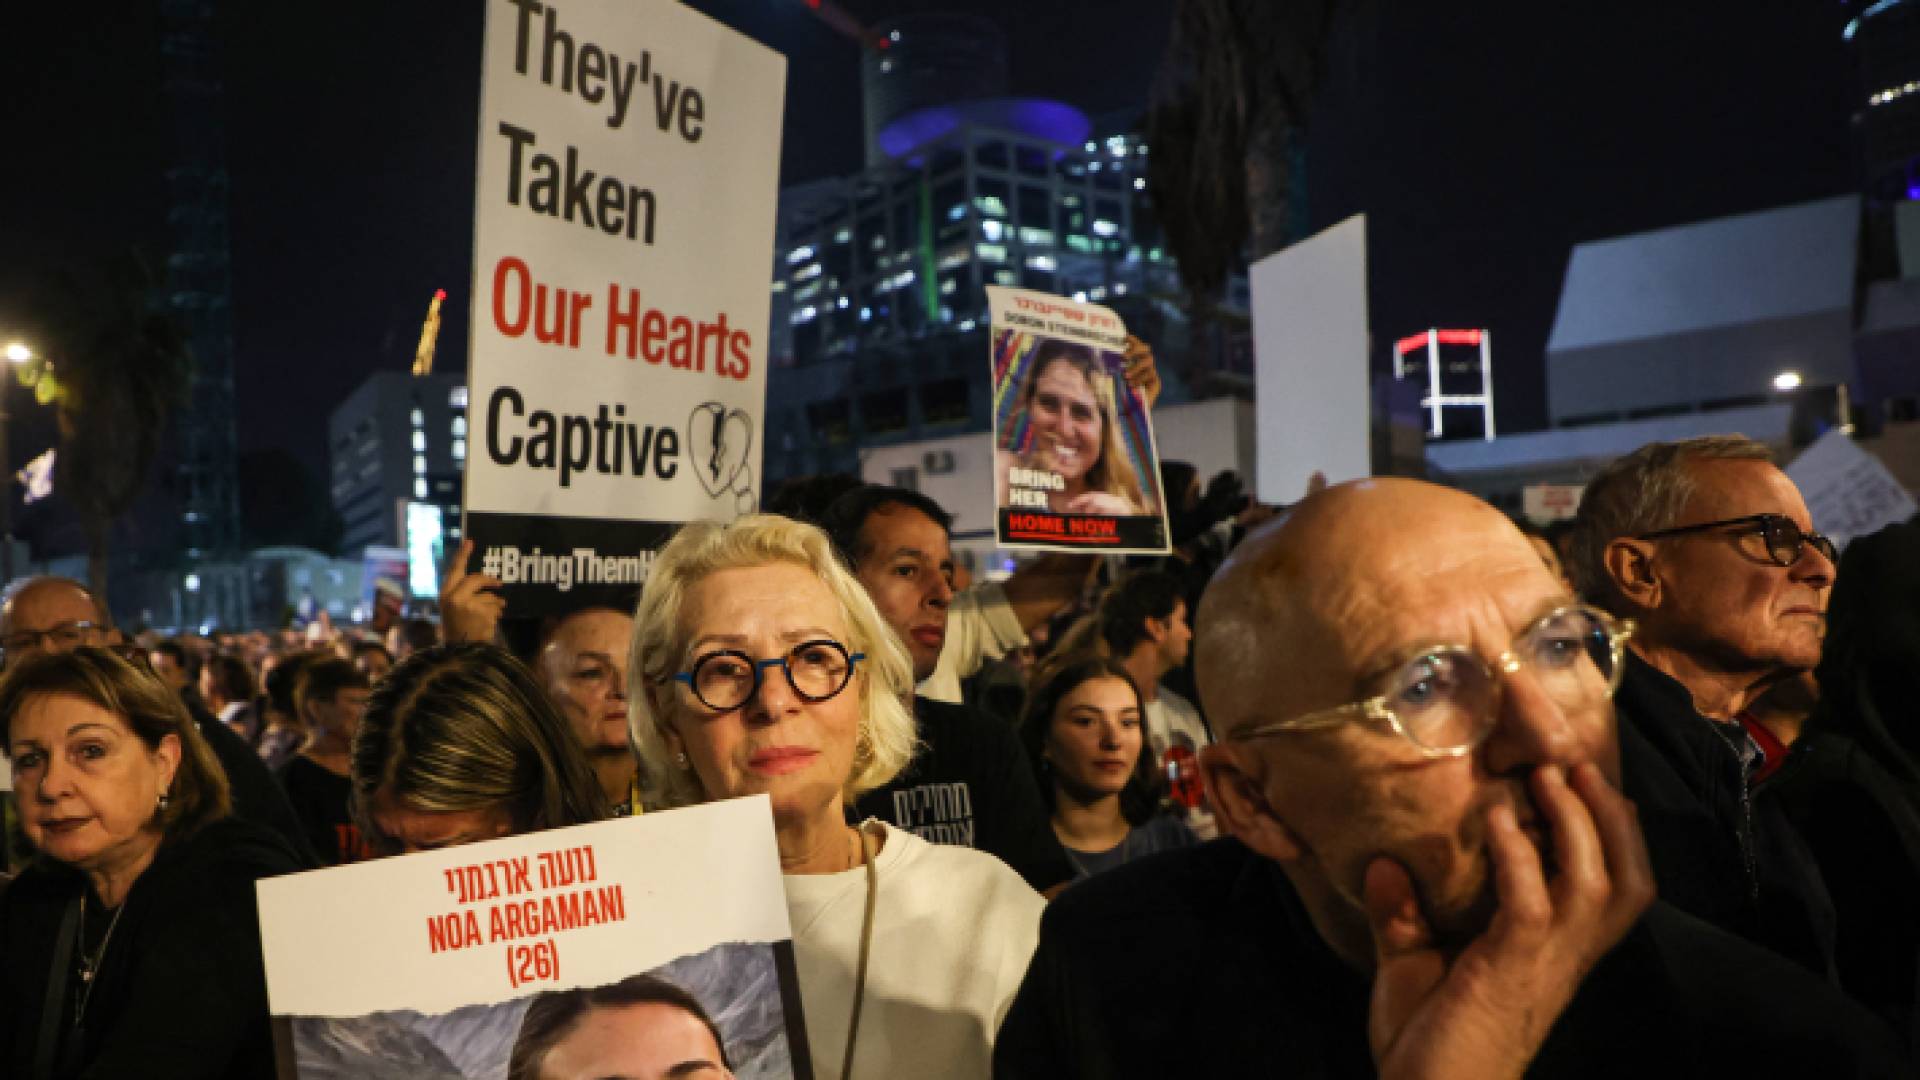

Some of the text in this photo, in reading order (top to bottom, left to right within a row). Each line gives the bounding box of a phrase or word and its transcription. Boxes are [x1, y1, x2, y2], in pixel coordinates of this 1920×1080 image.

[507, 0, 704, 143] They've
[499, 121, 657, 245] Taken
[492, 256, 751, 381] Our Hearts
[1005, 310, 1046, 328] DORON
[486, 385, 679, 488] Captive
[1009, 466, 1065, 491] BRING
[1009, 488, 1048, 508] HER
[1009, 512, 1117, 537] HOME NOW
[482, 547, 656, 592] #BringThemH
[443, 844, 598, 904] נועה ארגמני
[426, 883, 626, 953] NOA ARGAMANI
[506, 938, 560, 989] (26)
